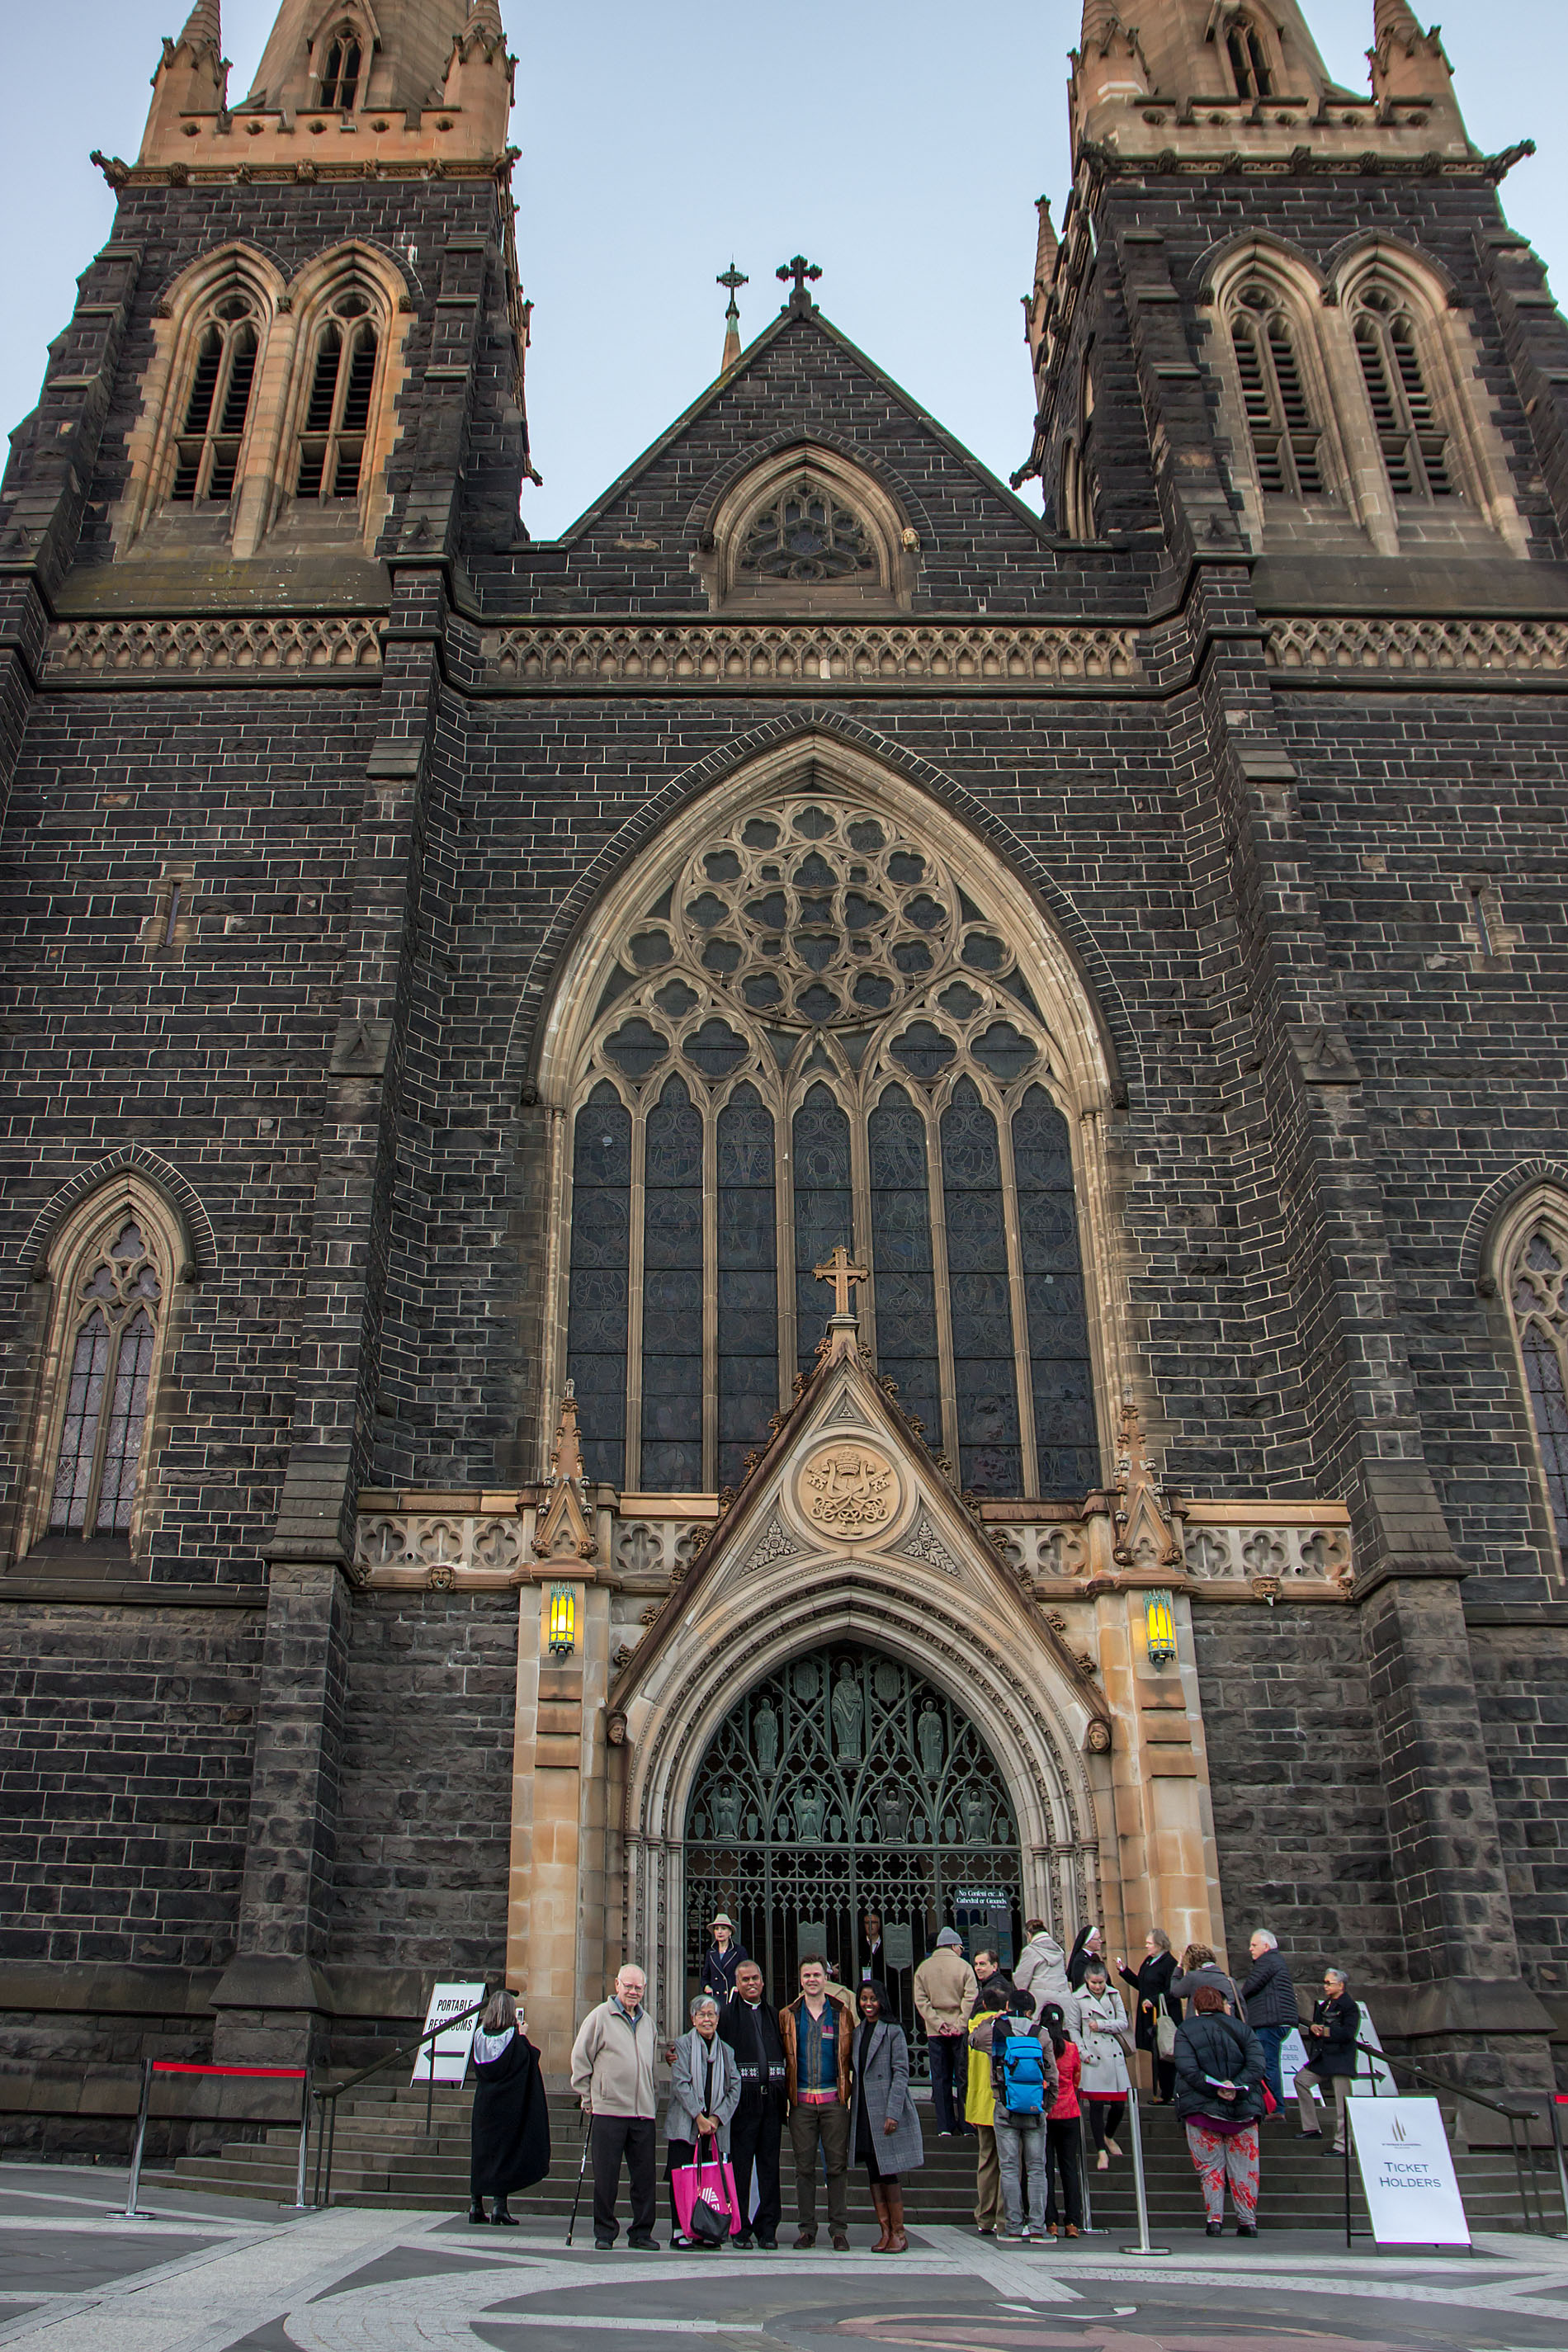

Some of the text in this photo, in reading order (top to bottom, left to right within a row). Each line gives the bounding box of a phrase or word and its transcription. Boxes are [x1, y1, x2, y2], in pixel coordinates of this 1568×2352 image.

[437, 1999, 474, 2011] PORTABLE
[1384, 2161, 1429, 2173] TICKET
[1379, 2176, 1442, 2188] HOLDERS
